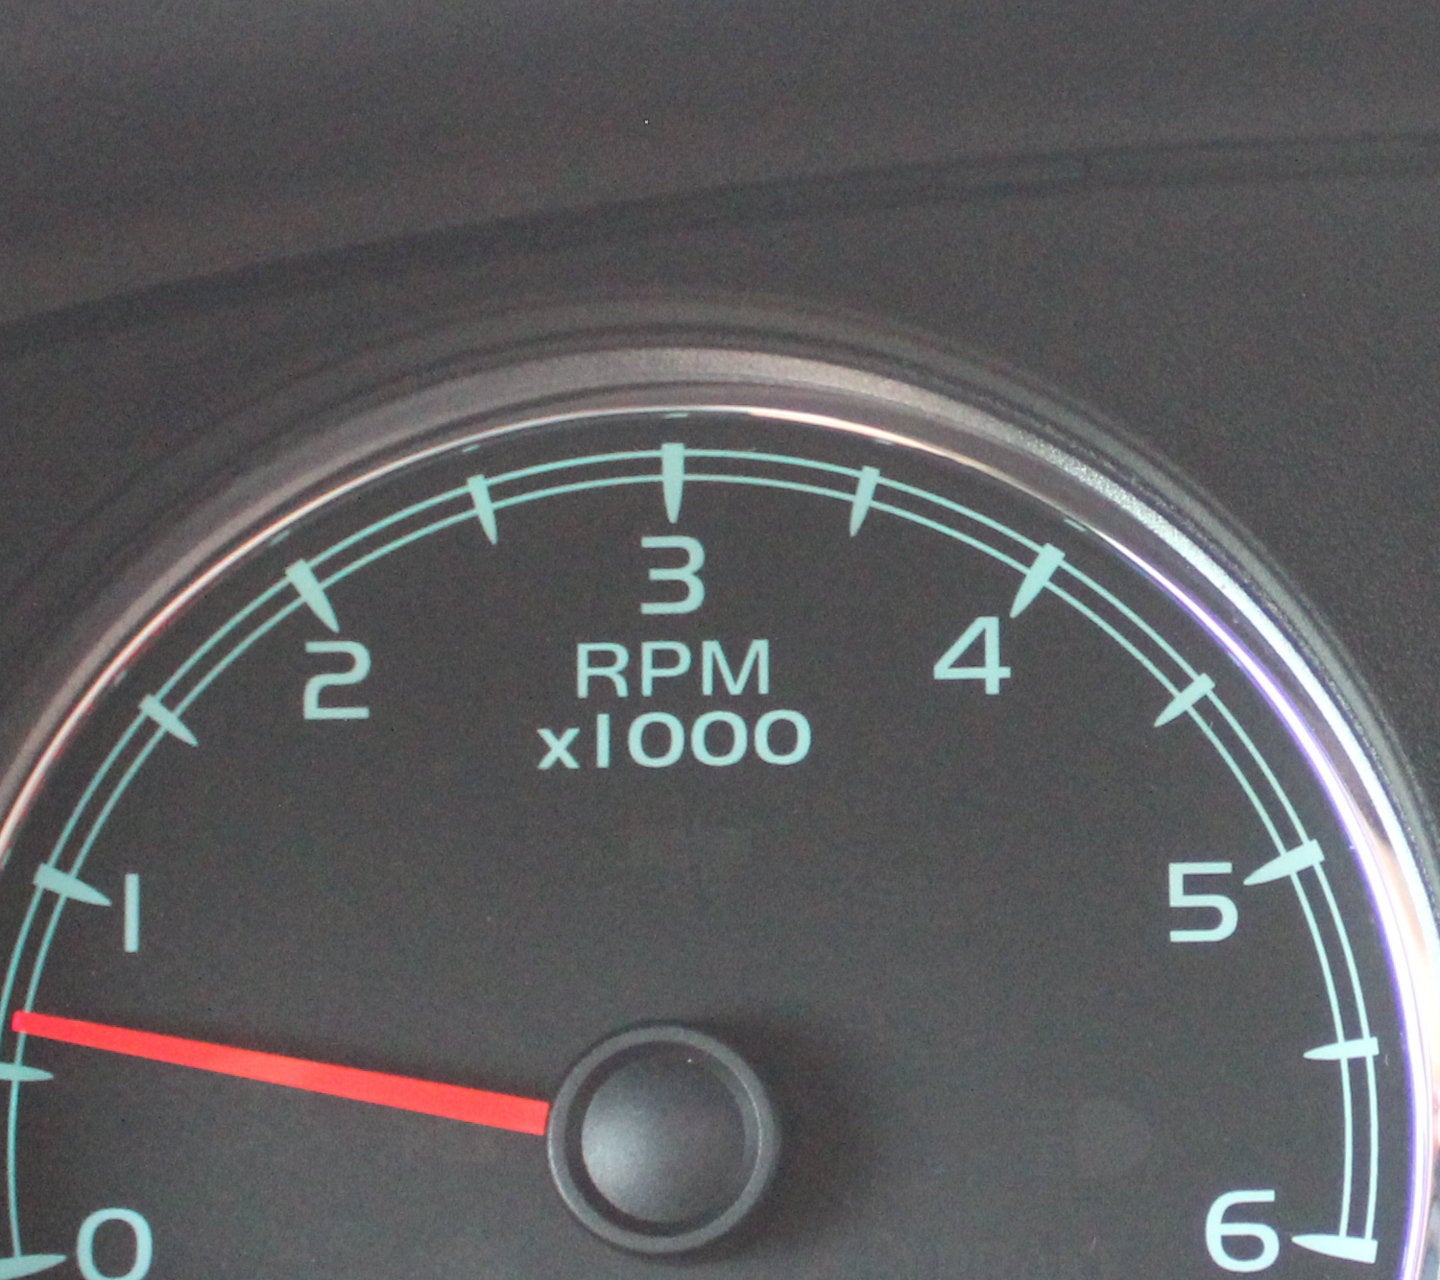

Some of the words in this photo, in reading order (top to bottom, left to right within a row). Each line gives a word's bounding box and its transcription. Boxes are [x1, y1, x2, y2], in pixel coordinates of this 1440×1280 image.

[641, 536, 704, 614] 3
[304, 641, 370, 719] 2
[577, 640, 769, 697] RPM
[934, 617, 1011, 694] 4
[539, 710, 811, 769] x1000
[125, 874, 139, 952] 1
[1169, 862, 1238, 942] 5
[1206, 1190, 1279, 1272] 6
